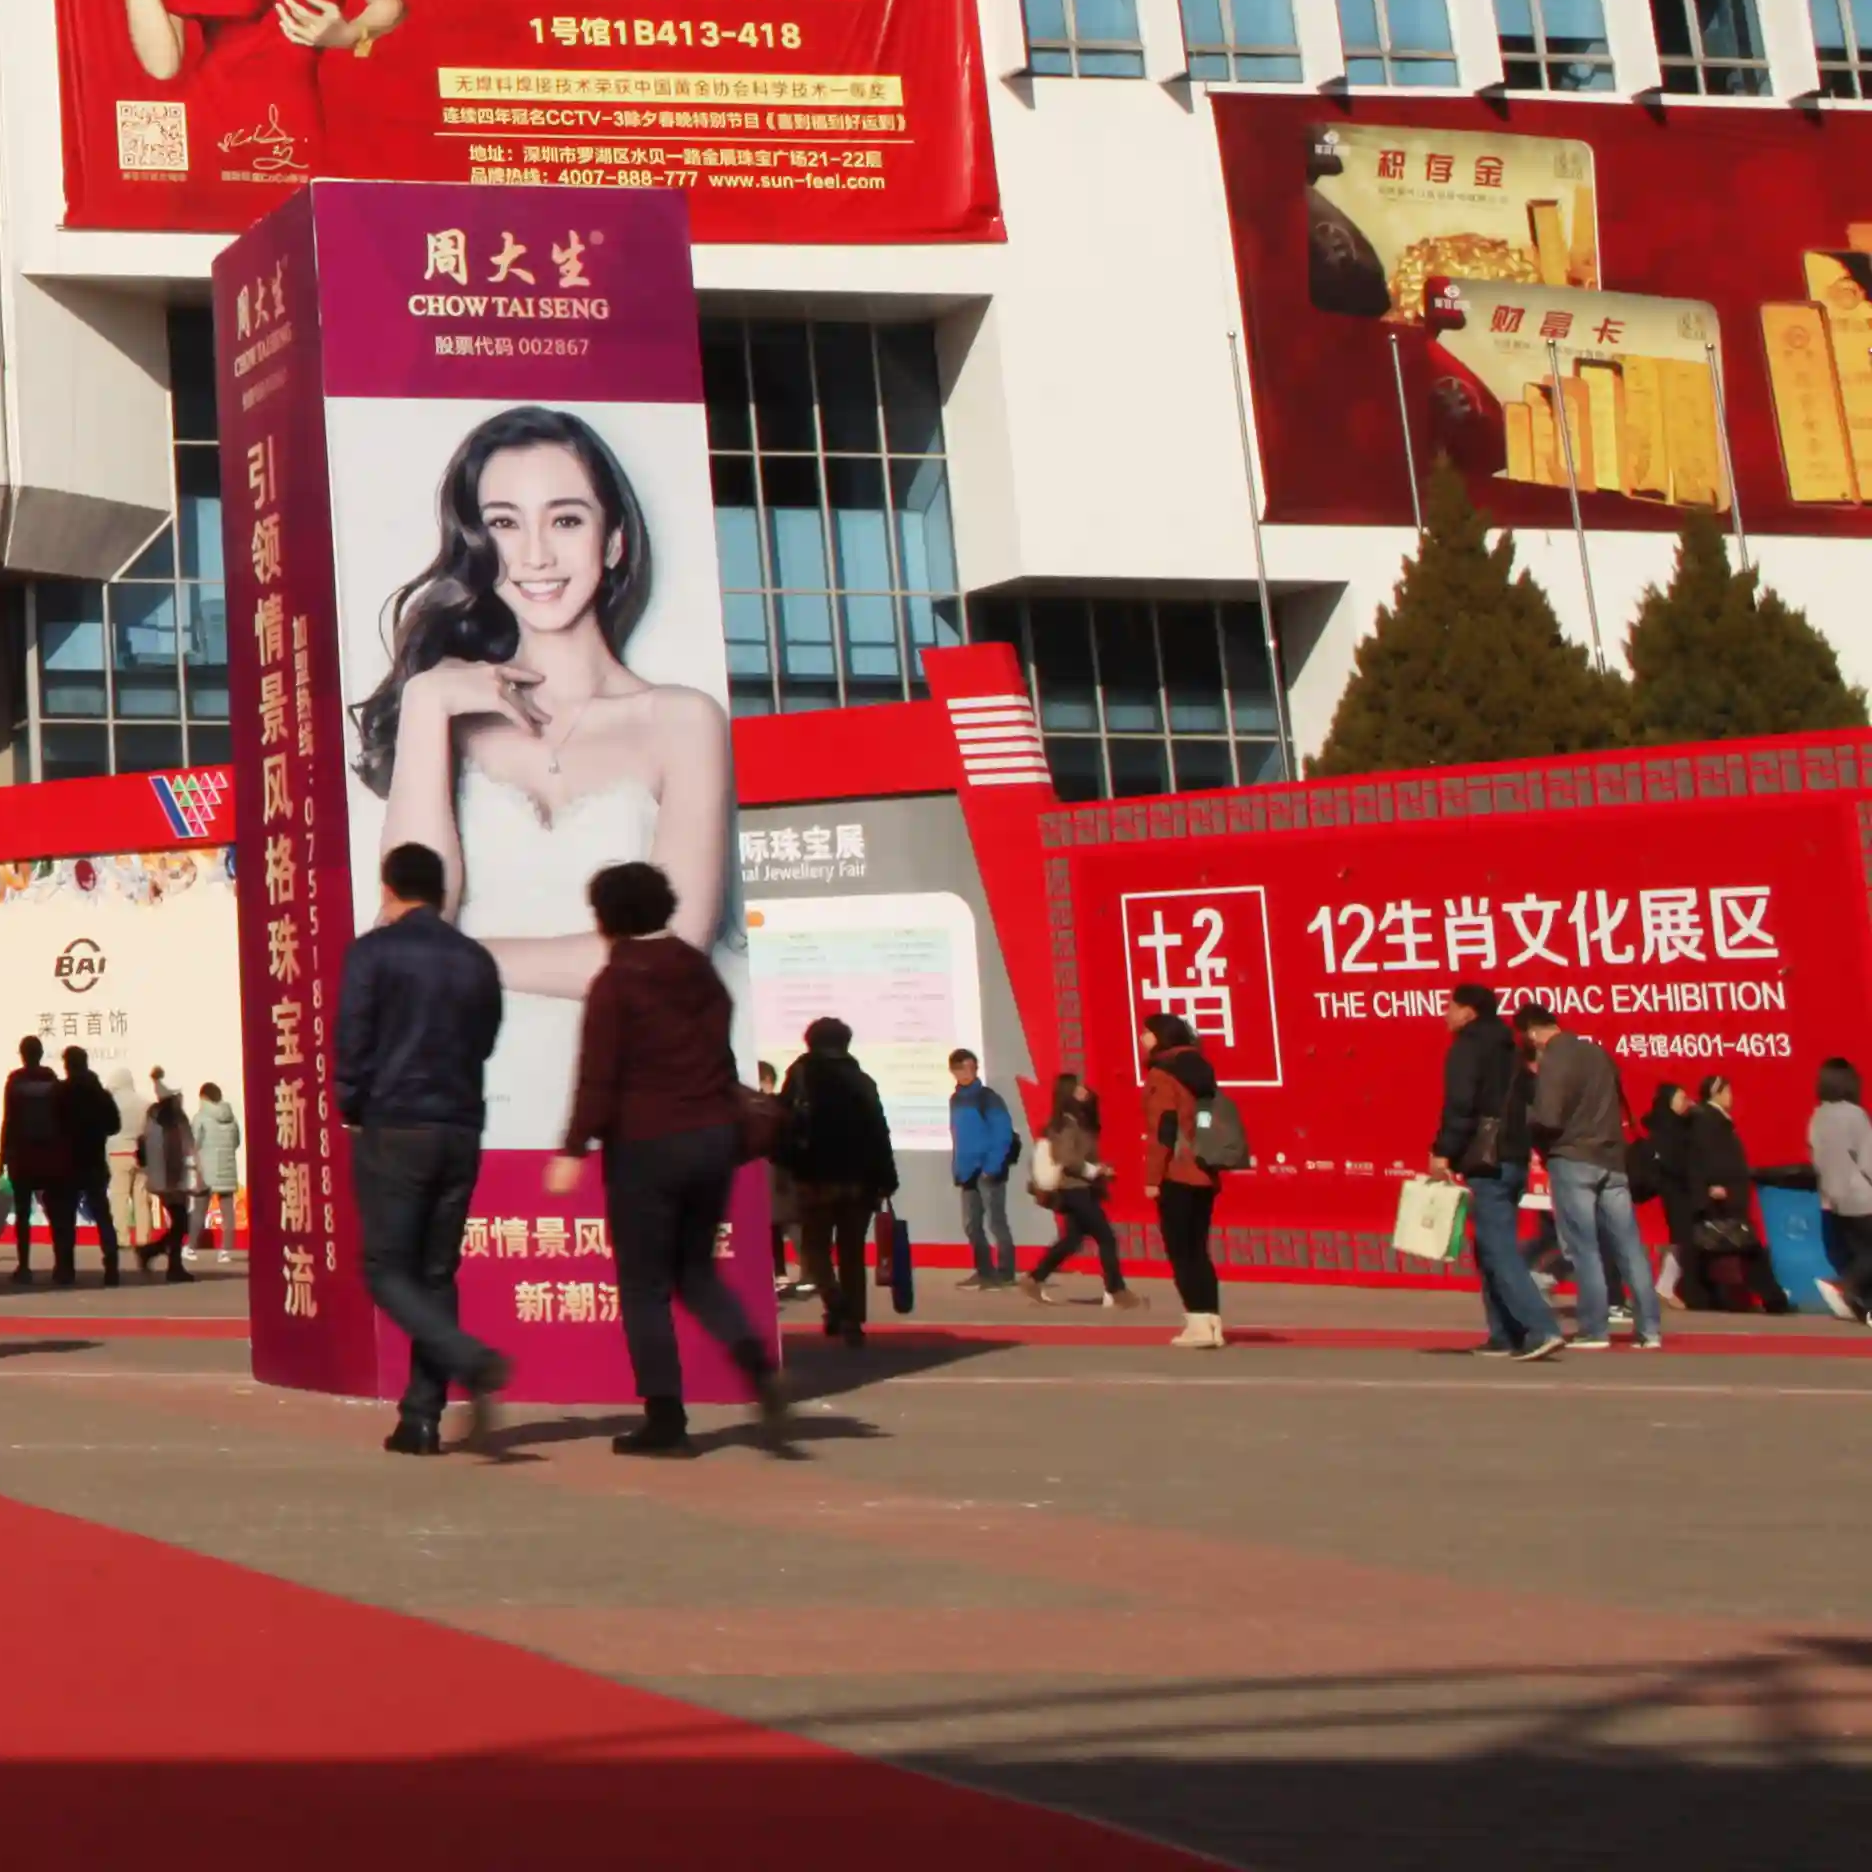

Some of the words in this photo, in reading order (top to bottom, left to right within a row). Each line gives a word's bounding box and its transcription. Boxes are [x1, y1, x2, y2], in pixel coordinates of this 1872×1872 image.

[529, 16, 802, 51] 1号馆1B413-418
[709, 172, 885, 191] www.sun-feel.com
[1377, 148, 1505, 189] 积存金
[423, 227, 594, 288] 周大生
[408, 294, 489, 318] CHOW
[491, 296, 535, 319] TAI
[537, 297, 610, 320] SENG
[1490, 304, 1626, 345] 财富卡
[435, 335, 514, 357] 股票代码
[518, 337, 590, 357] 002867
[738, 823, 865, 866] 际珠宝展
[763, 861, 834, 884] Jewellery
[838, 859, 867, 879] Fair
[1306, 884, 1780, 975] 12生肖文化展区
[54, 955, 107, 978] BAI
[1314, 989, 1369, 1020] THE
[1373, 986, 1453, 1019] CHINE
[1496, 983, 1606, 1014] ZODIAC
[1610, 981, 1787, 1013] EXHIBITION
[36, 1008, 129, 1038] 菜百首饰
